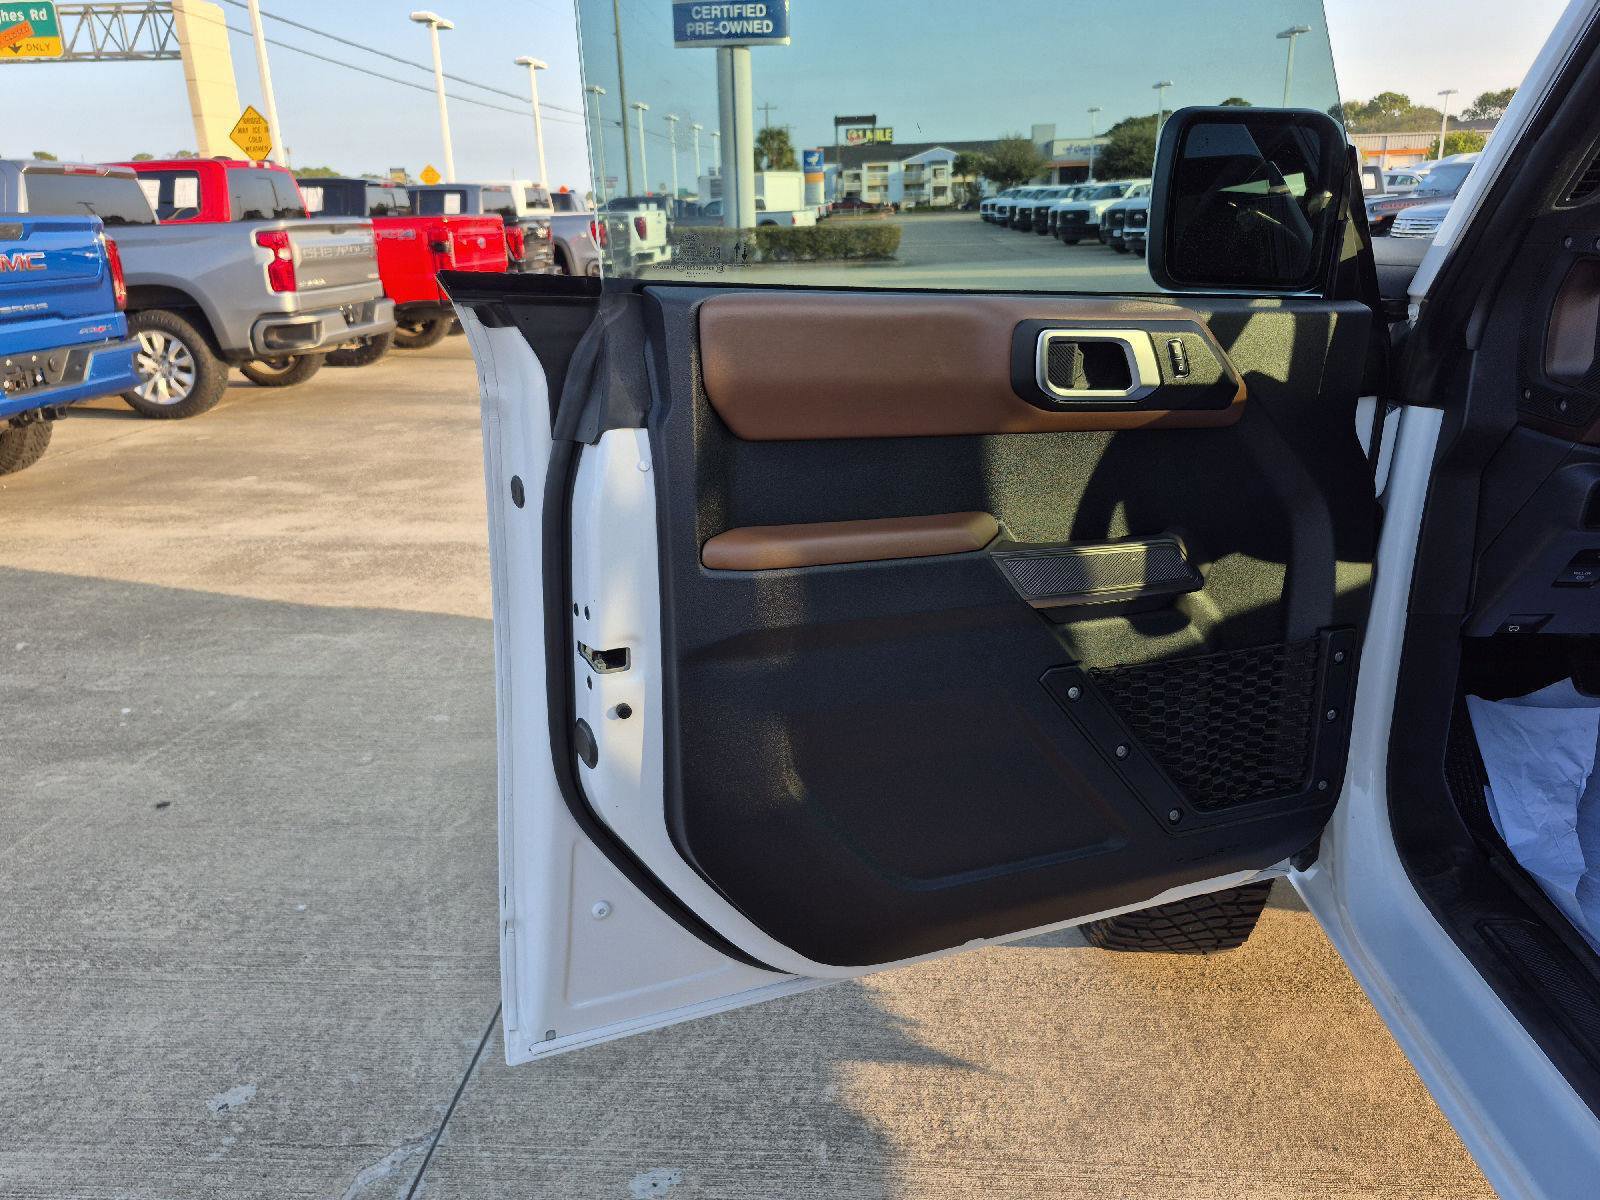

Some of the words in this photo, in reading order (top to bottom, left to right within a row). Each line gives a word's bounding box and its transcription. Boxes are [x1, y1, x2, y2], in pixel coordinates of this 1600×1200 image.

[0, 9, 25, 22] hes
[30, 8, 48, 21] Rd
[691, 3, 767, 20] CERTIFIED
[686, 20, 774, 36] PRE-OWNED
[26, 43, 50, 52] ONLY
[0, 251, 47, 272] MC
